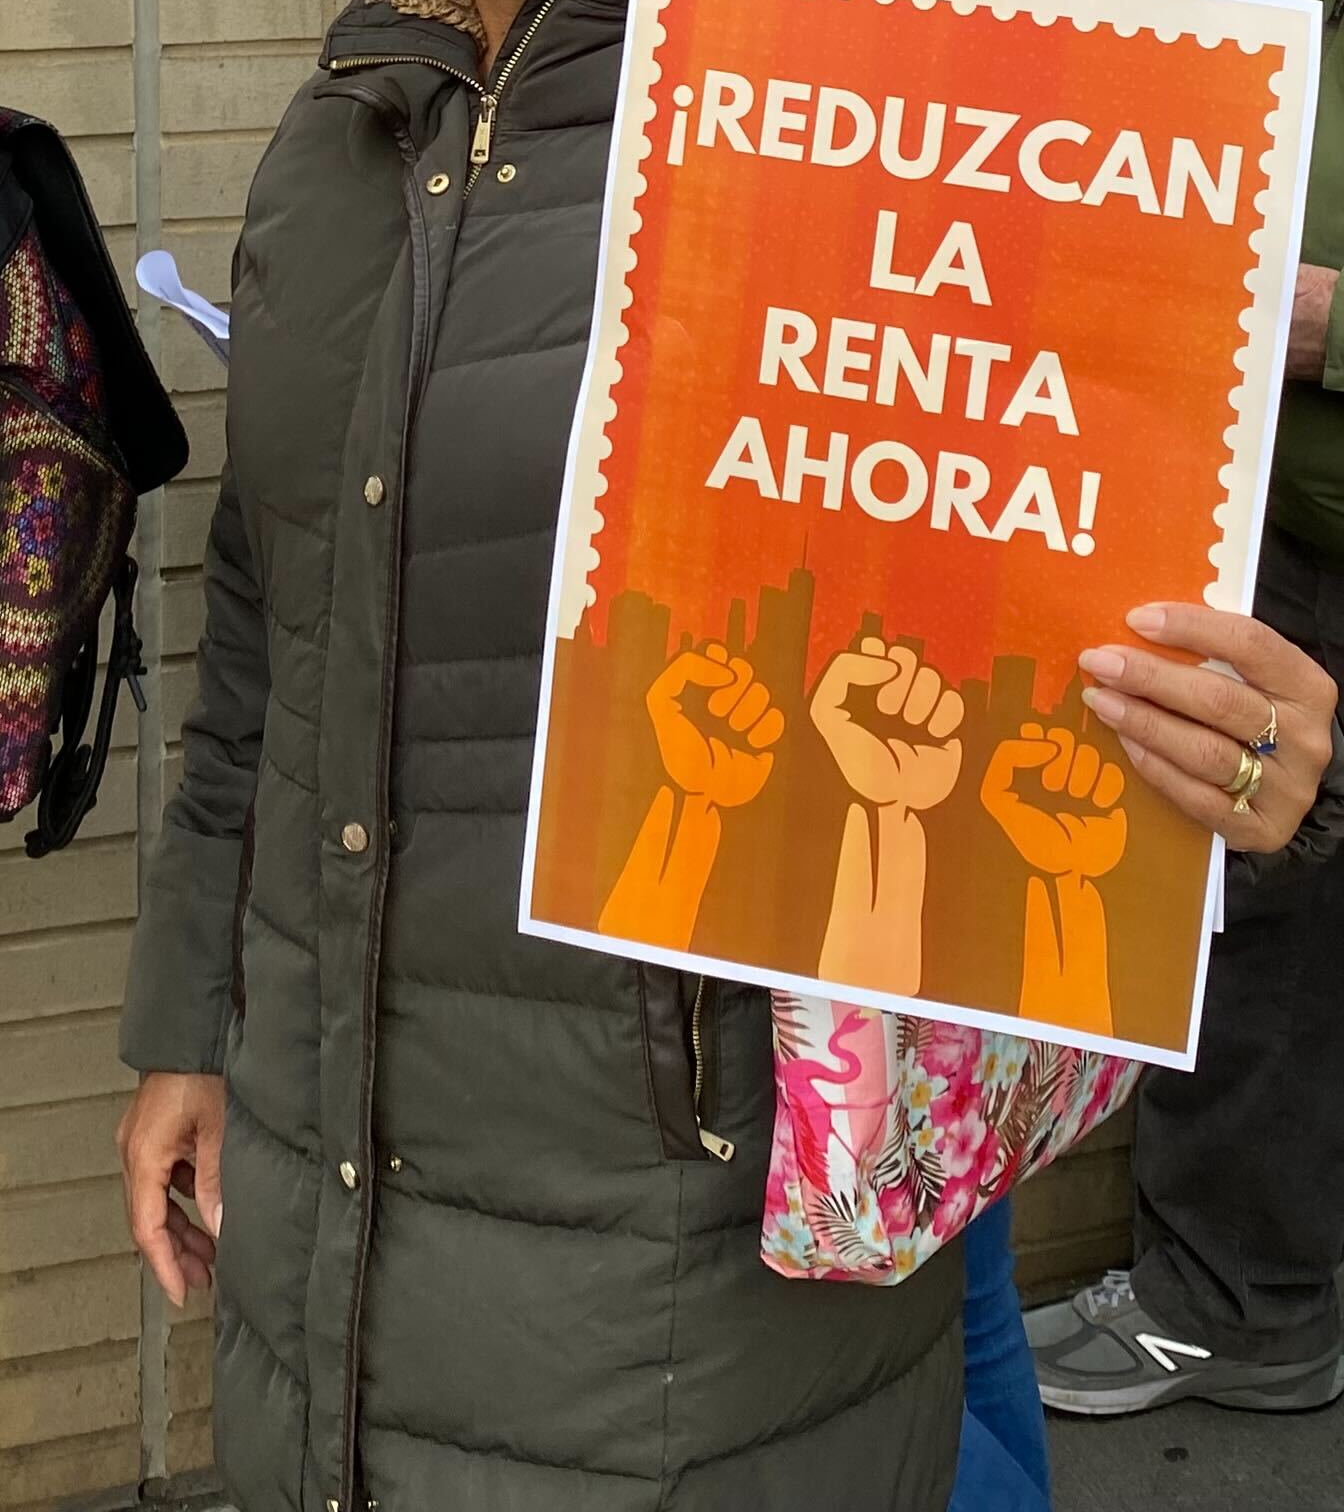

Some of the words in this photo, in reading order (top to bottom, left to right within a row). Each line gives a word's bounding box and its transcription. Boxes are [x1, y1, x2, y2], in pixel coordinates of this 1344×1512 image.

[667, 69, 1245, 226] ¡REDUZCAN
[868, 209, 994, 307] LA
[758, 306, 1081, 437] RENTA
[704, 415, 1102, 557] AHORA!
